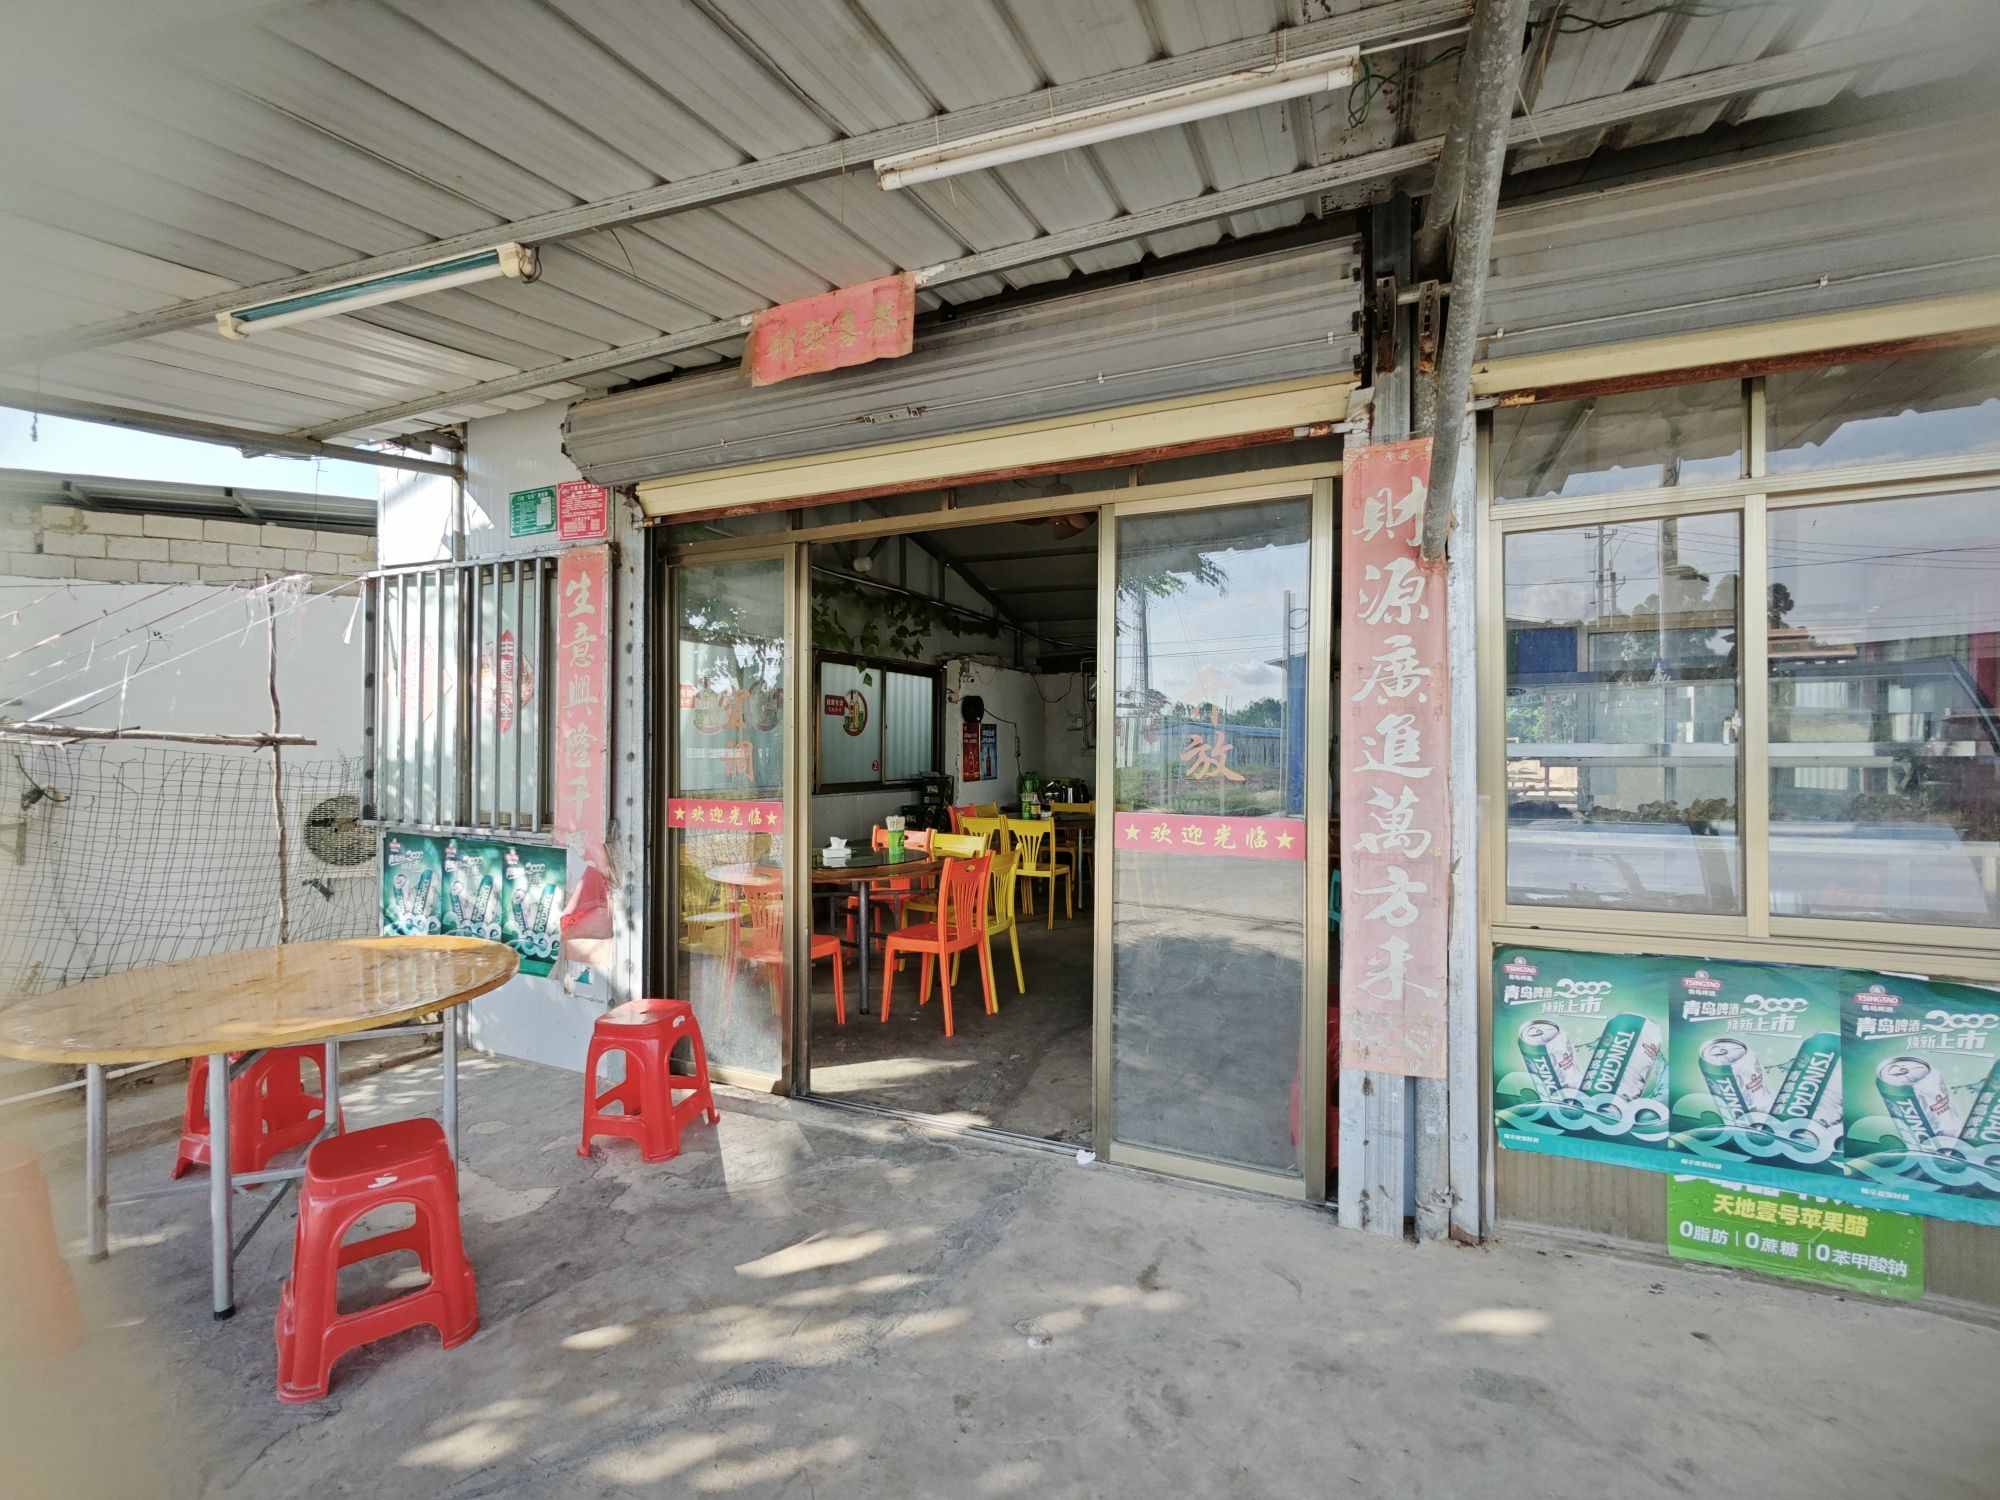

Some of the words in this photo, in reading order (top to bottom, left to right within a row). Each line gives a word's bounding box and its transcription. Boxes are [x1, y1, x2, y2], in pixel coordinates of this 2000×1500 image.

[690, 805, 763, 826] 欢迎光临
[1150, 822, 1268, 850] 欢迎光临
[1504, 965, 1537, 975] TSINGTAO
[1684, 978, 1721, 989] TSINGTAO
[1503, 985, 1553, 1004] 青岛啤酒
[1856, 994, 1899, 1005] TSINGTAO
[1682, 999, 1740, 1020] 青岛啤酒
[1856, 1017, 1921, 1039] 青岛啤酒
[1593, 1031, 1636, 1093] TSINGTAO
[1786, 1050, 1835, 1118] TSINGTAO
[1712, 1193, 1870, 1239] 天地壹号苹果醋
[1679, 1220, 1729, 1247] 0脂肪
[1745, 1231, 1799, 1259] 0蔗糖
[1815, 1243, 1908, 1279] 0苯甲酸钠
